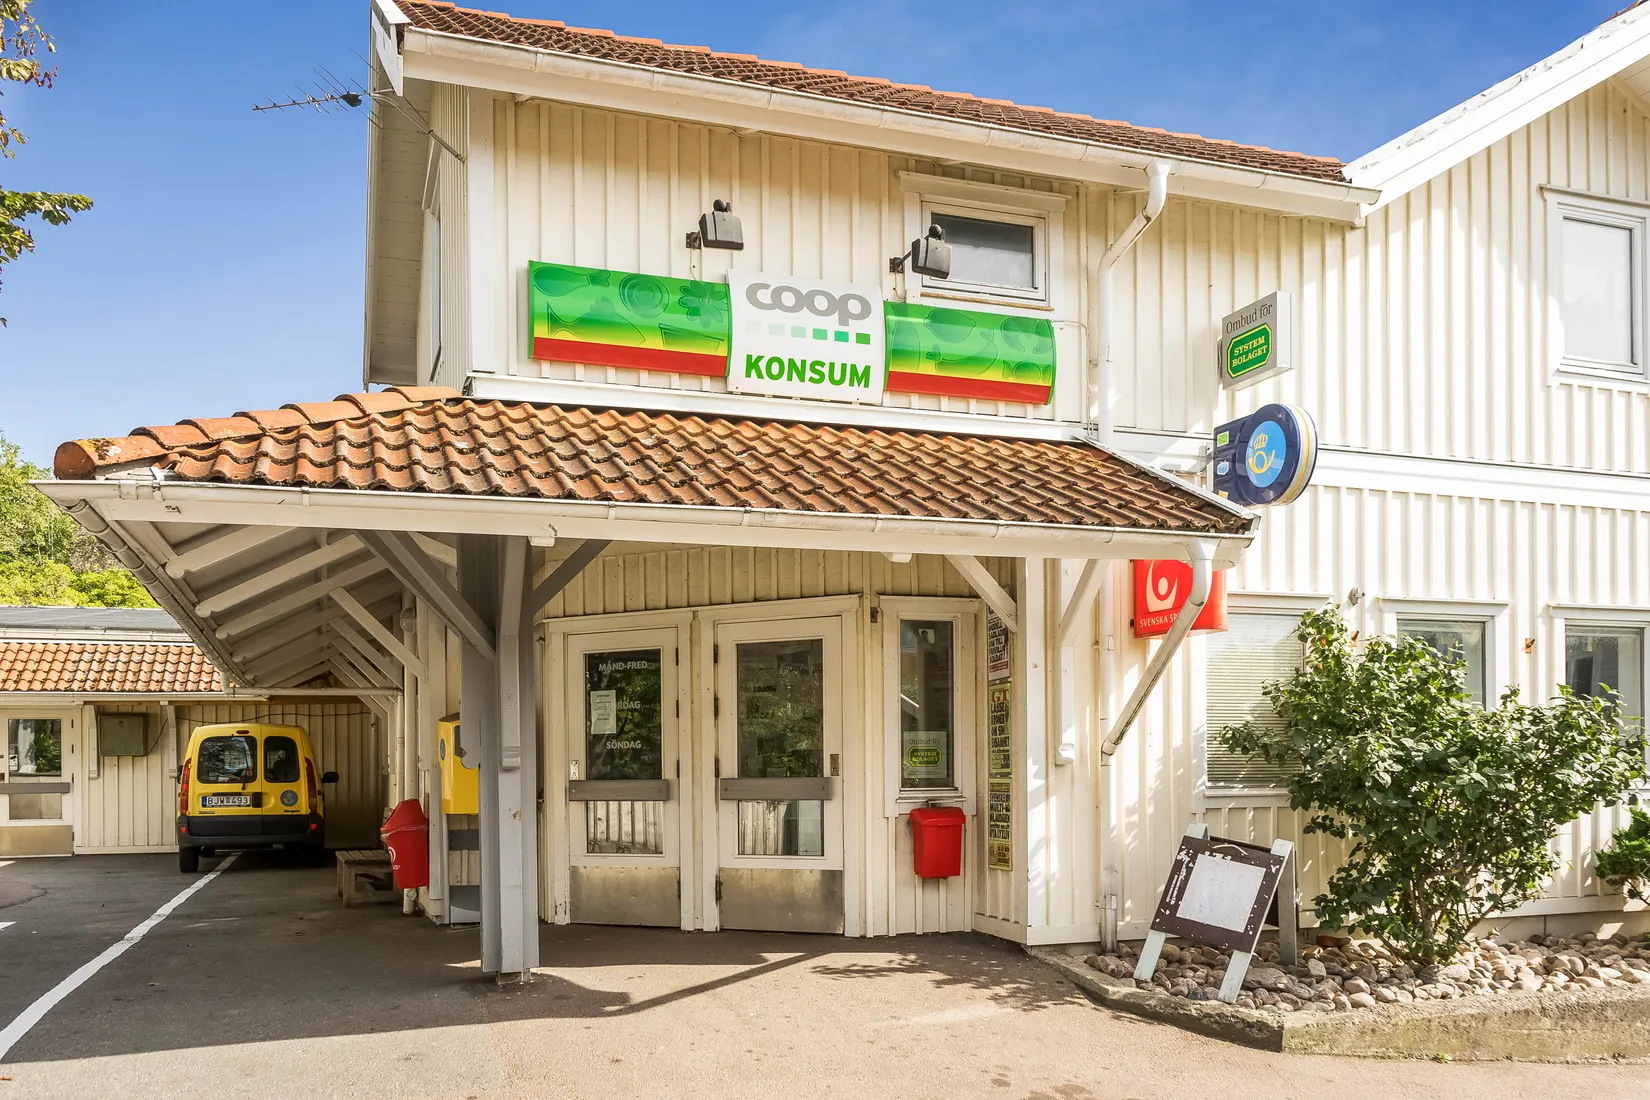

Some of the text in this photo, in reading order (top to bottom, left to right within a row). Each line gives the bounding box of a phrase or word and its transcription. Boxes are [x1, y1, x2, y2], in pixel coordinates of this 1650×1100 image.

[745, 282, 872, 327] coop
[1226, 303, 1273, 334] Ombud för
[1233, 335, 1265, 356] SYSTEM
[1231, 345, 1268, 367] BOLAGET
[745, 354, 871, 389] KONSUM
[1139, 613, 1180, 628] SVENSKA SP
[598, 660, 648, 672] MÅND-FRED
[992, 687, 1010, 702] GT
[606, 700, 641, 710] LRDAG
[991, 702, 1005, 714] LASSE
[606, 739, 642, 750] SÖNDAG
[231, 796, 249, 804] 493
